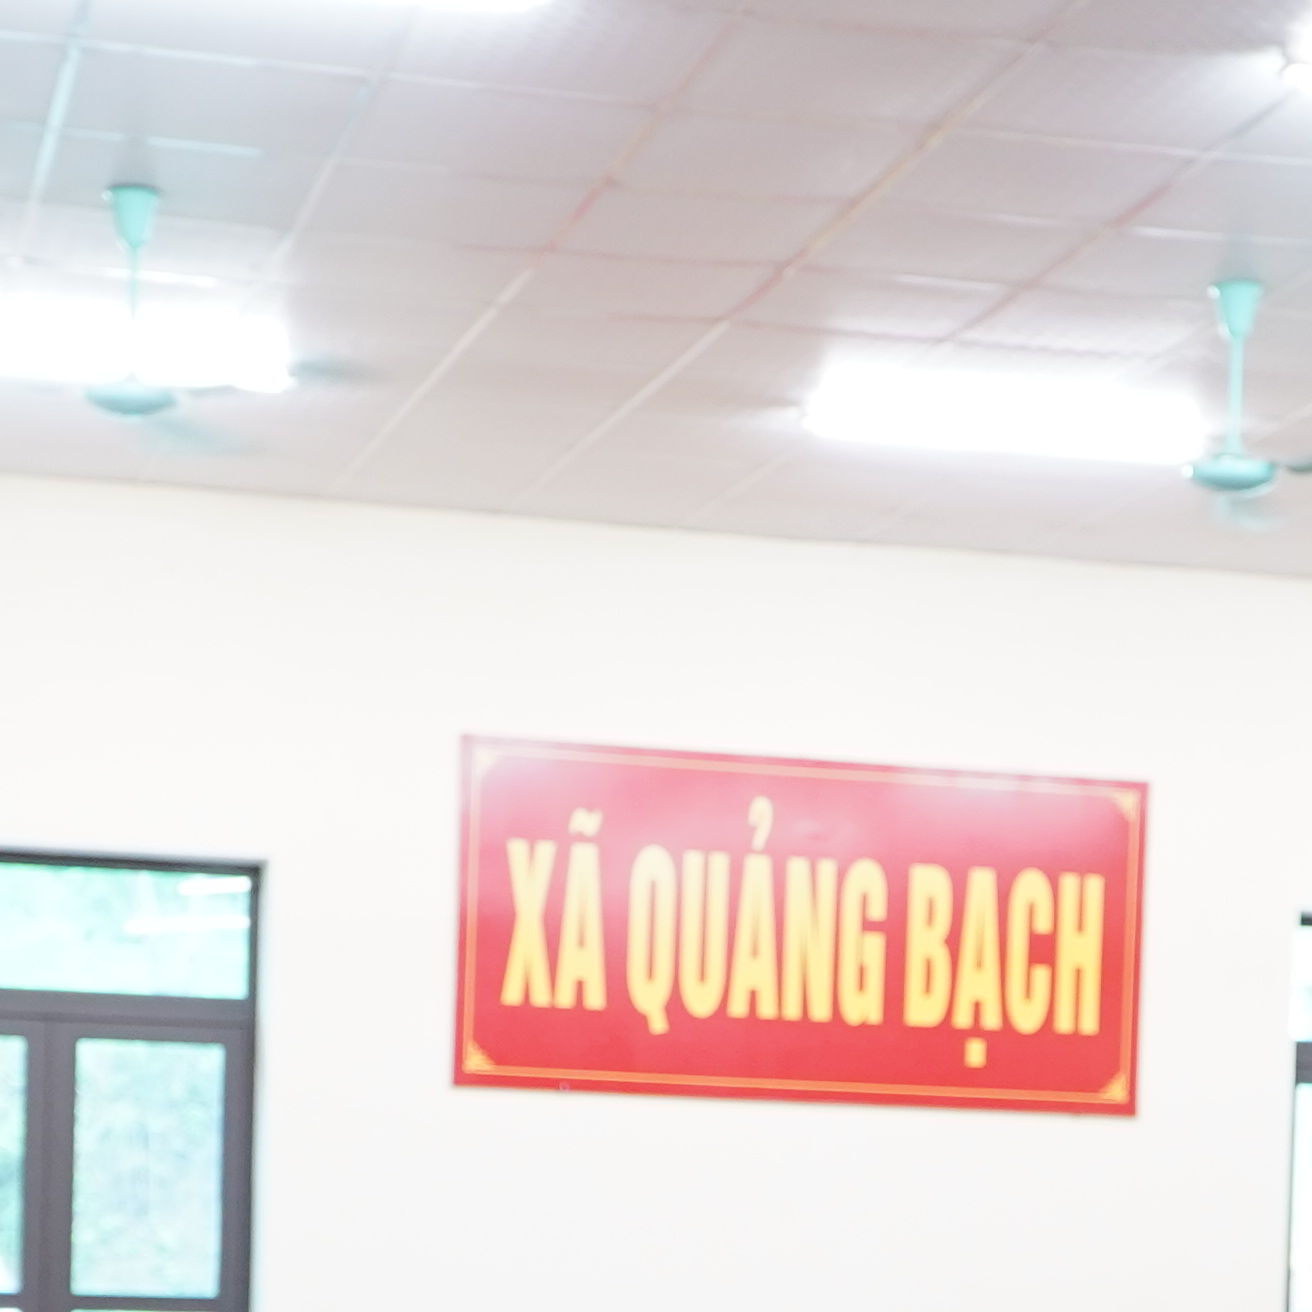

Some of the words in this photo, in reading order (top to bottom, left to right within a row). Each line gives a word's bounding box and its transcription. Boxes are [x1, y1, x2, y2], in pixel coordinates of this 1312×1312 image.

[499, 807, 608, 1012] XÃ
[625, 795, 888, 1036] QUẢNG
[902, 863, 1106, 1069] BẠCH
